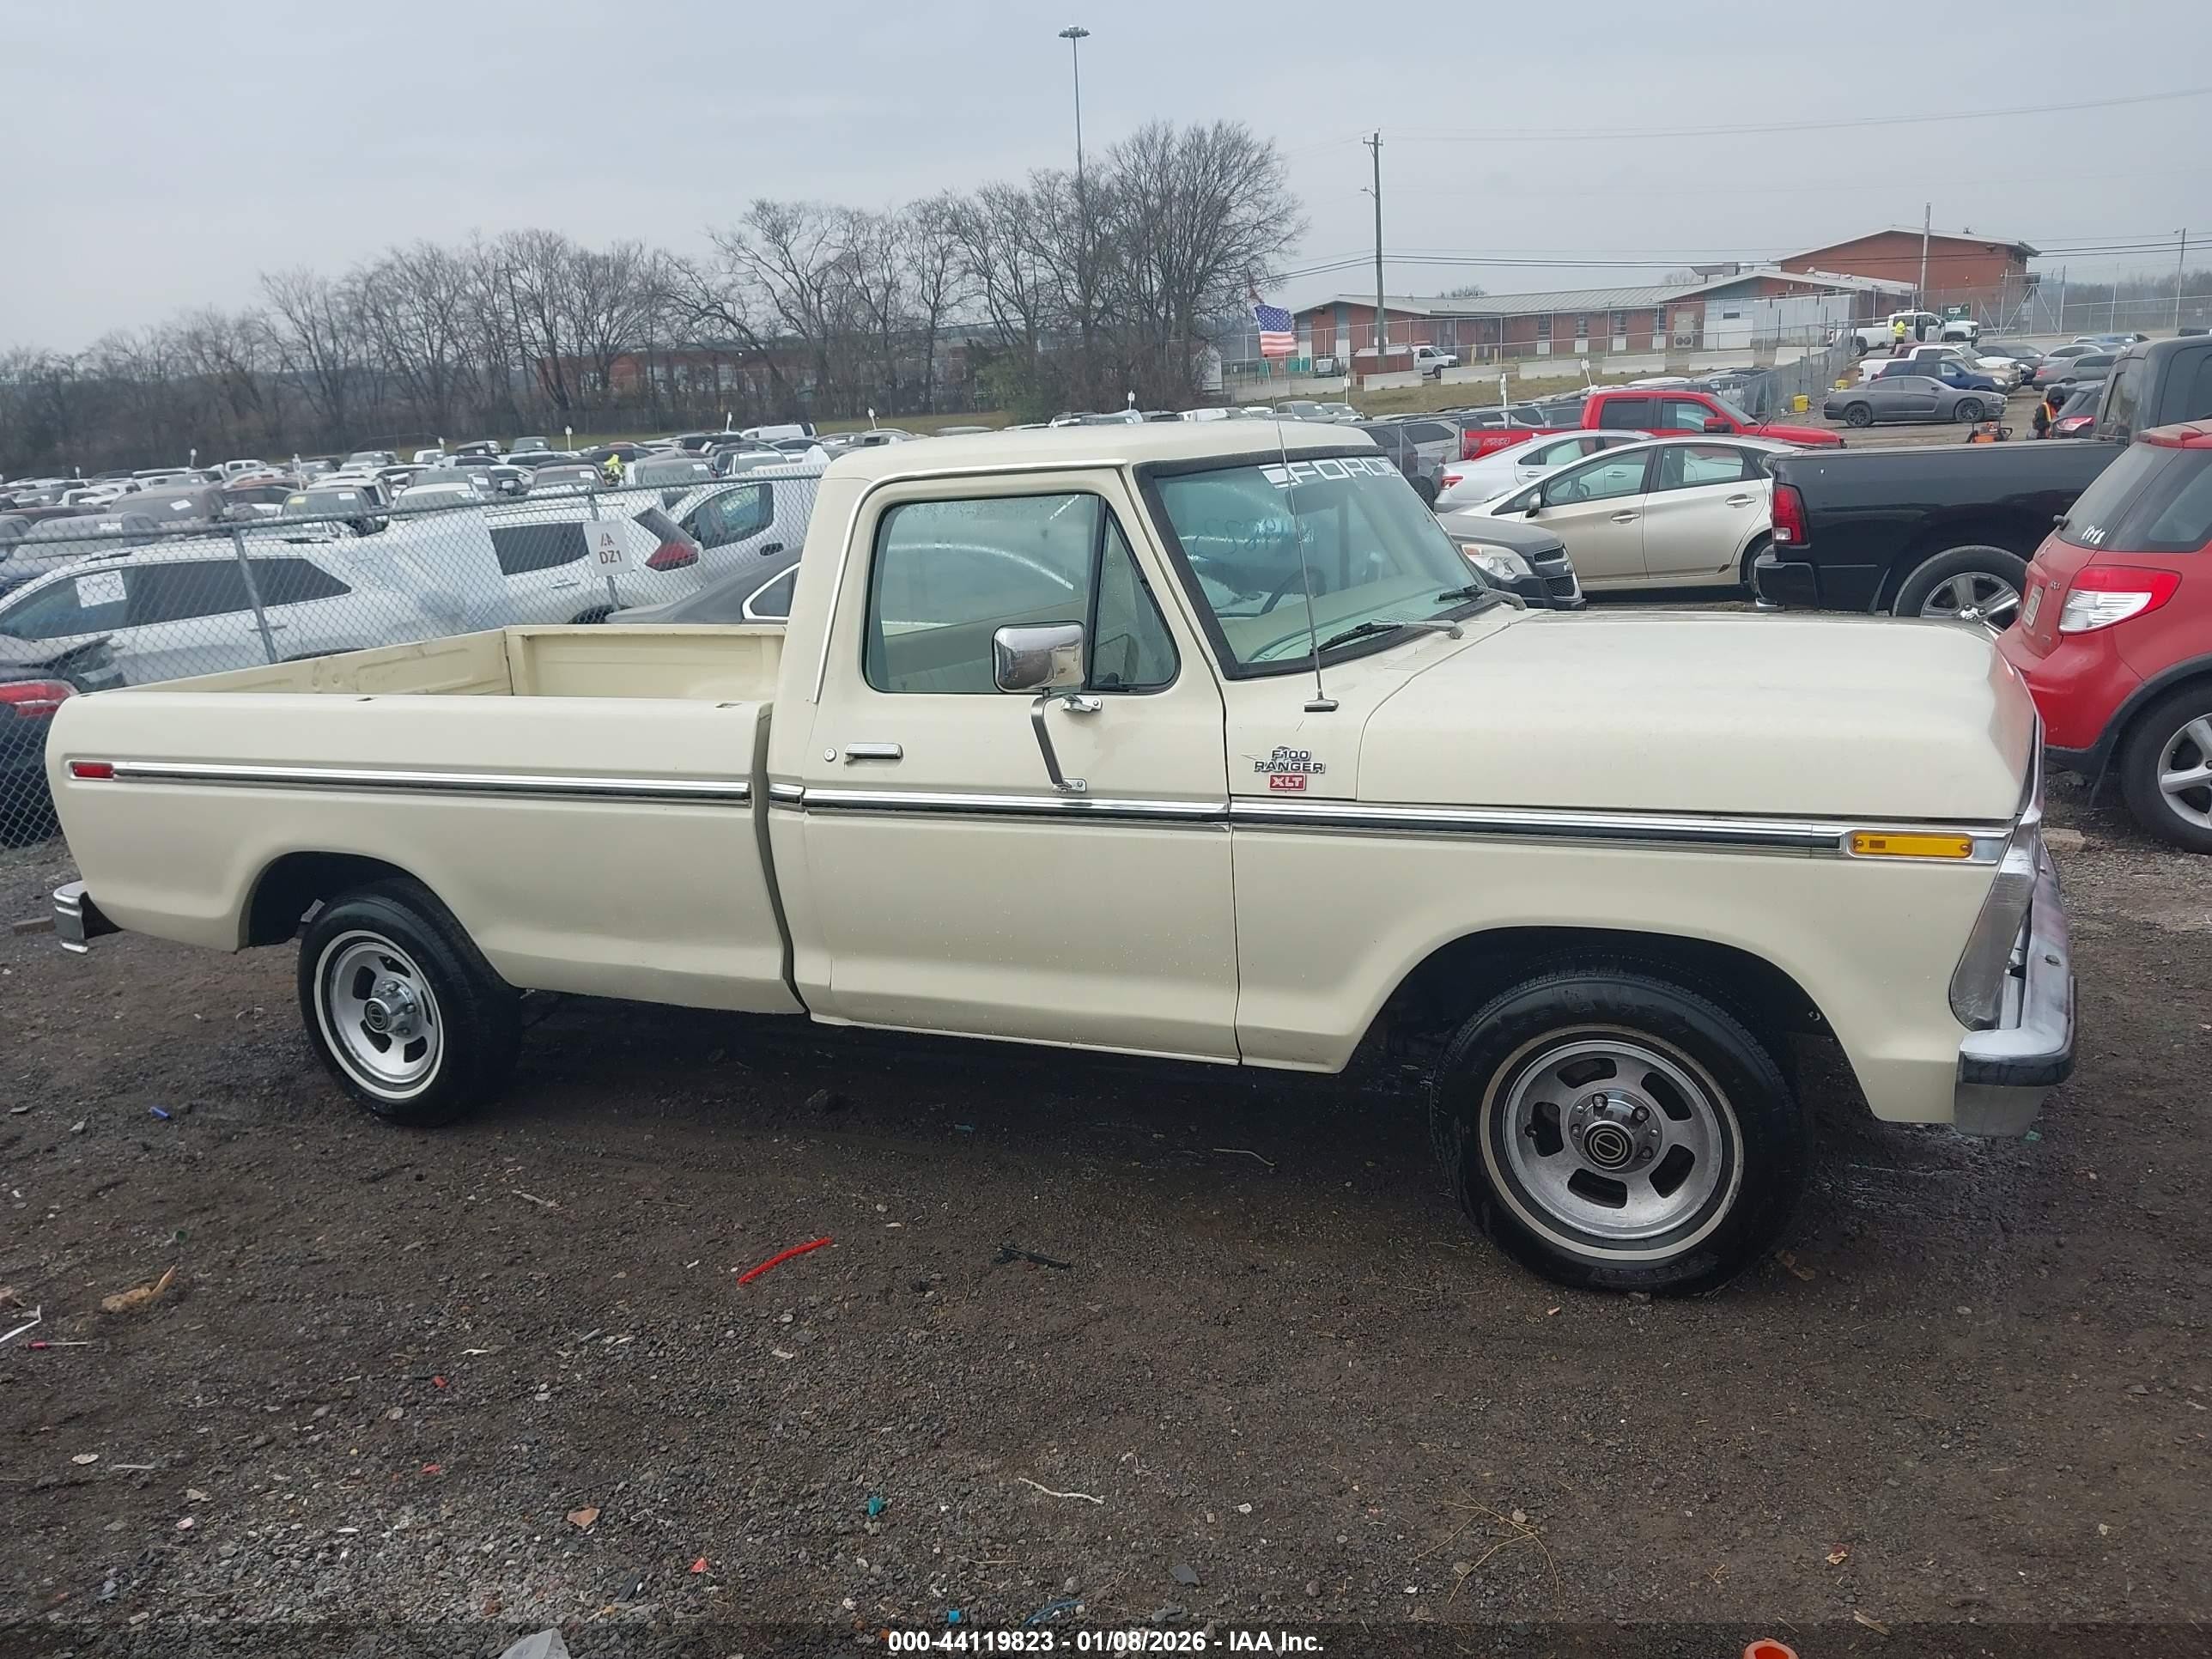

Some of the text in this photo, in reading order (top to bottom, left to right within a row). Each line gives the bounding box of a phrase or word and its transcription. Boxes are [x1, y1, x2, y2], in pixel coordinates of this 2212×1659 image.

[1287, 458, 1392, 483] FORD
[599, 550, 623, 565] DZ1
[1271, 750, 1310, 761] F100
[1254, 761, 1325, 773] RANGER
[1272, 776, 1304, 787] XLT
